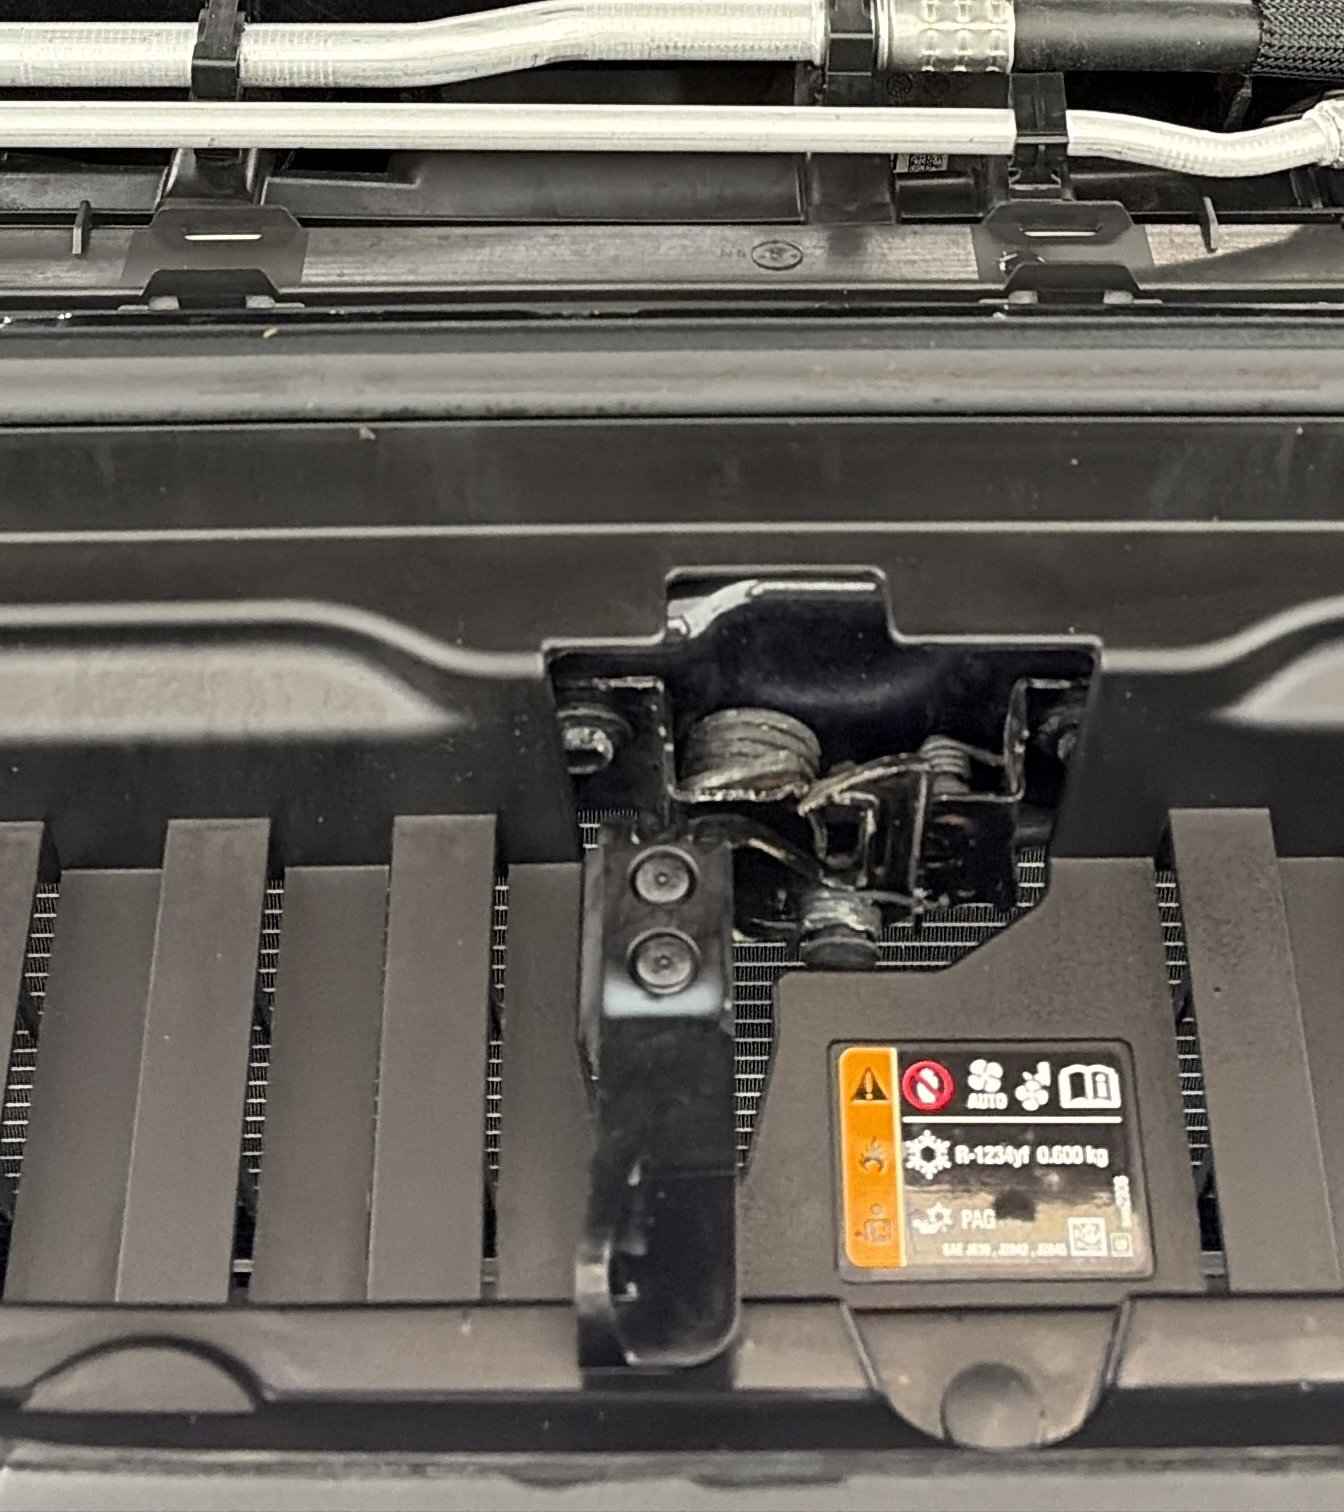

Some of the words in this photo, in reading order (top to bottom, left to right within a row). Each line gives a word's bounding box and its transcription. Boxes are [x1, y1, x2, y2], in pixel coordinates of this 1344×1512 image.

[967, 1092, 1008, 1110] AUTO
[1036, 1144, 1084, 1165] 0.600
[1085, 1144, 1109, 1168] kg
[961, 1208, 997, 1230] PAG
